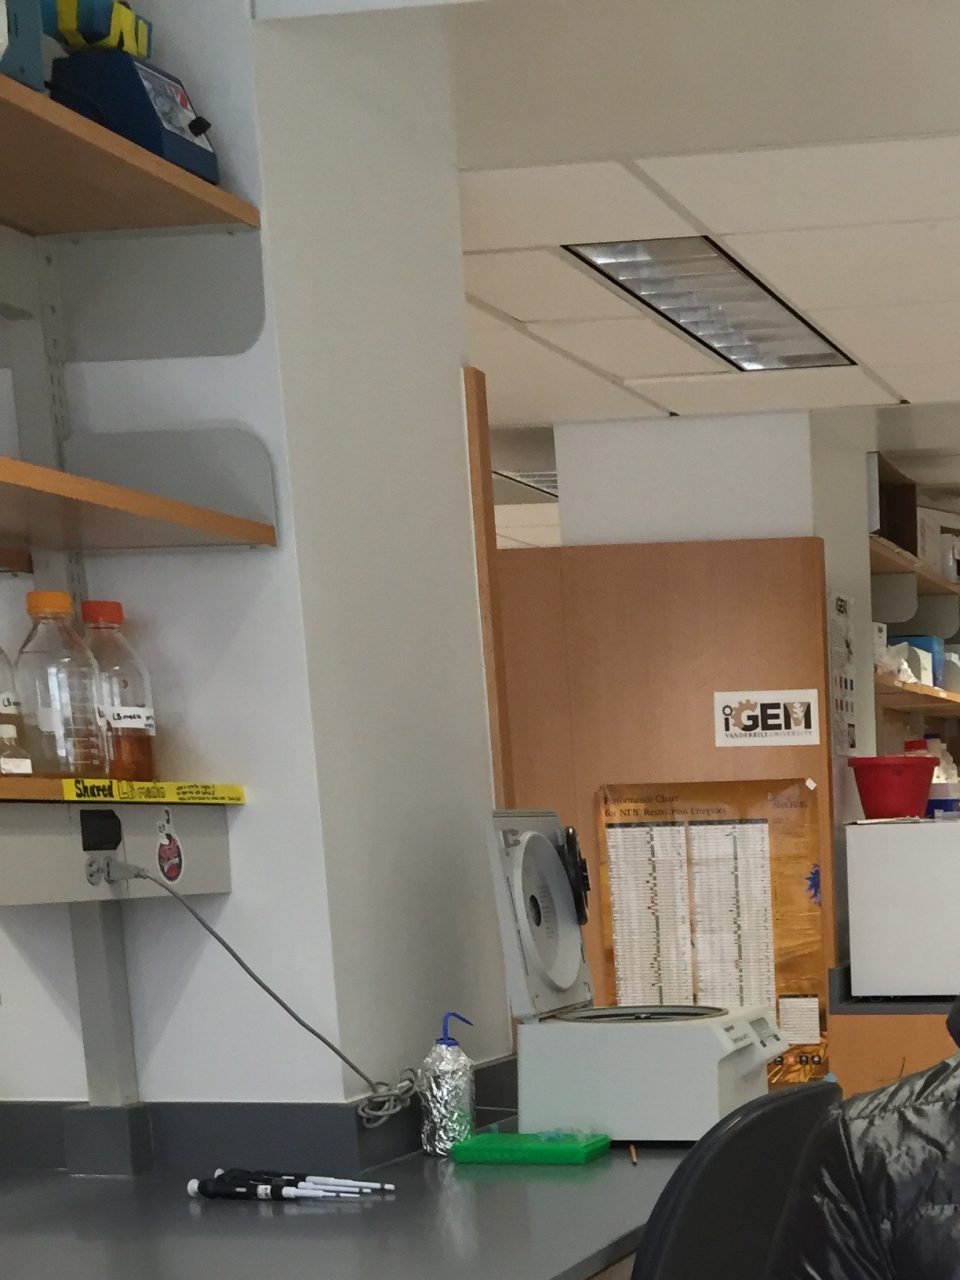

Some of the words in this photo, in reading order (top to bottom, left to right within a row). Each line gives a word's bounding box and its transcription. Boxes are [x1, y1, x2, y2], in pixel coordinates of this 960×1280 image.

[722, 700, 812, 732] iGEM
[724, 731, 768, 739] VANDERBILT
[74, 779, 114, 799] Shared
